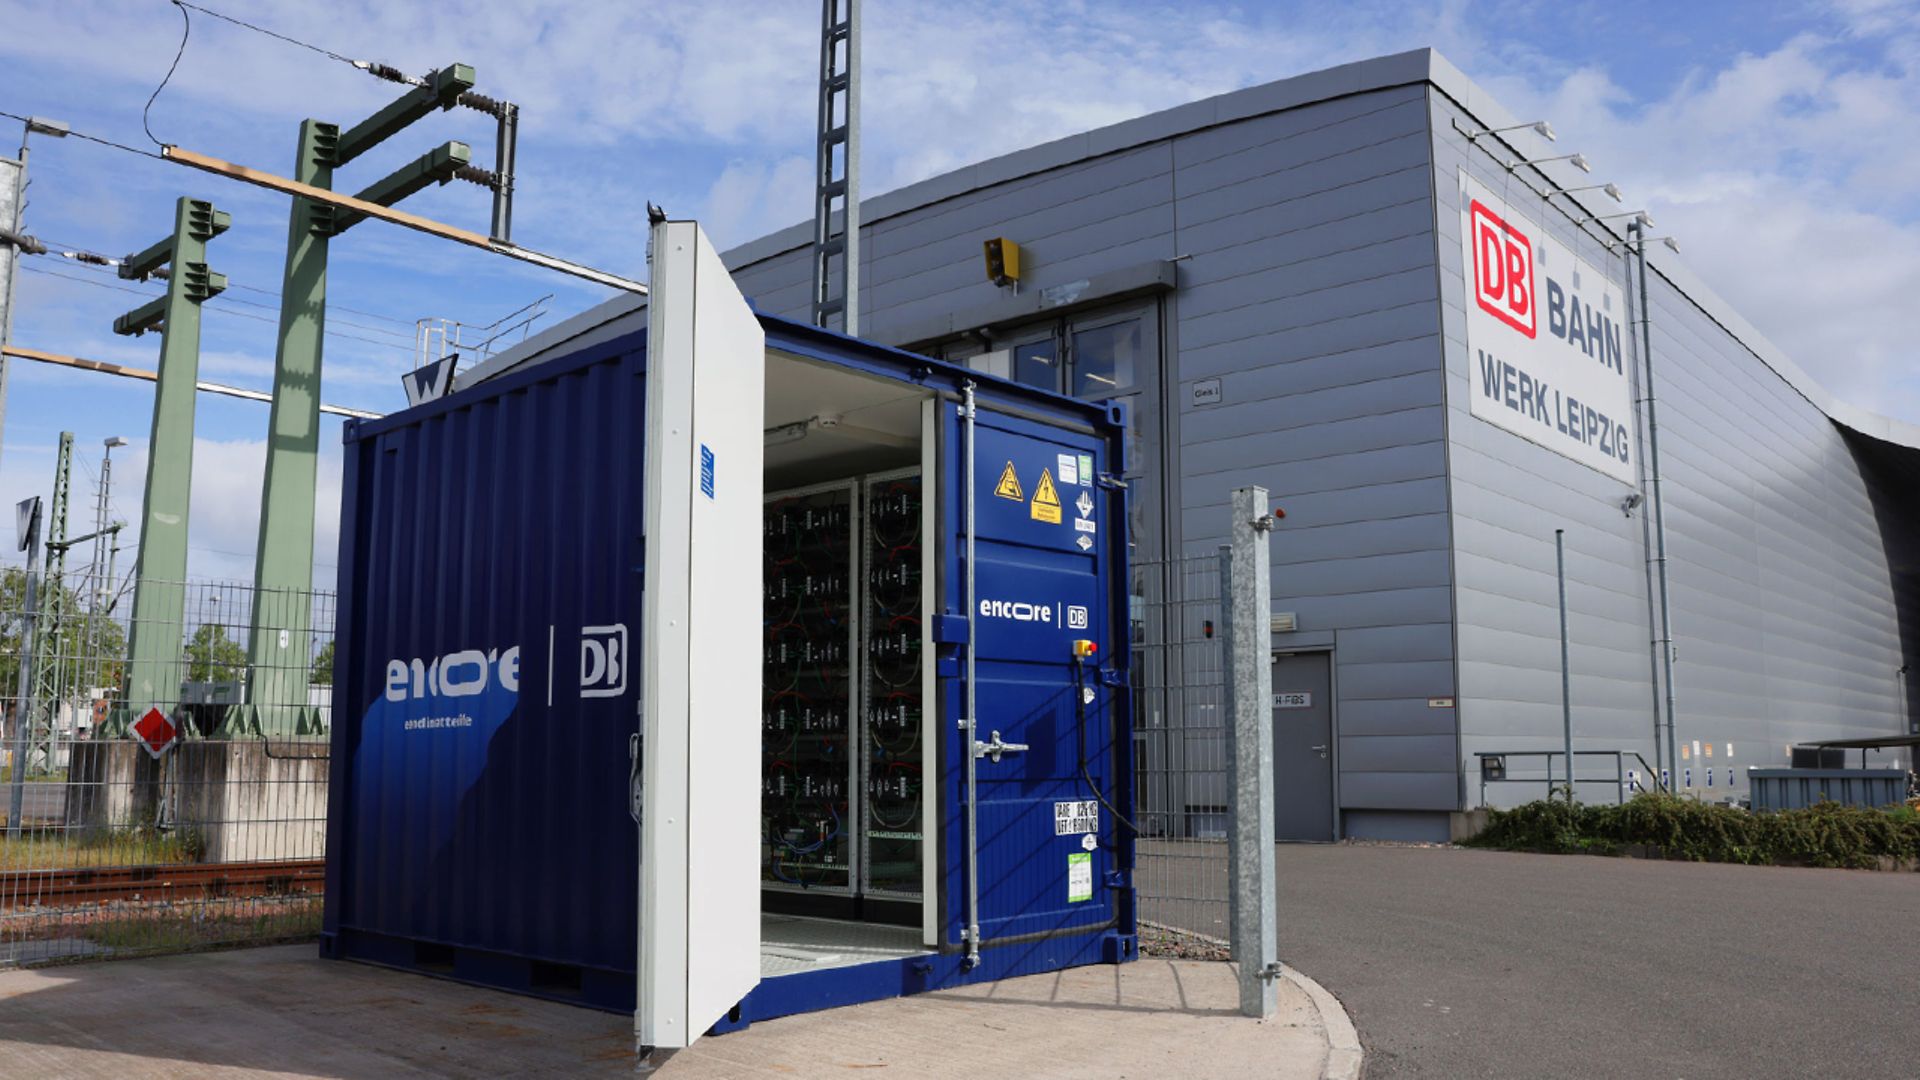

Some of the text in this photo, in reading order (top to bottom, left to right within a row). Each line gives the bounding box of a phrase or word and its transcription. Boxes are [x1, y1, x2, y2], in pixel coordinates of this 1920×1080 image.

[1479, 218, 1623, 376] DB BAHN
[1478, 348, 1629, 465] WERK LEIPZIG
[980, 599, 1086, 627] encore DB
